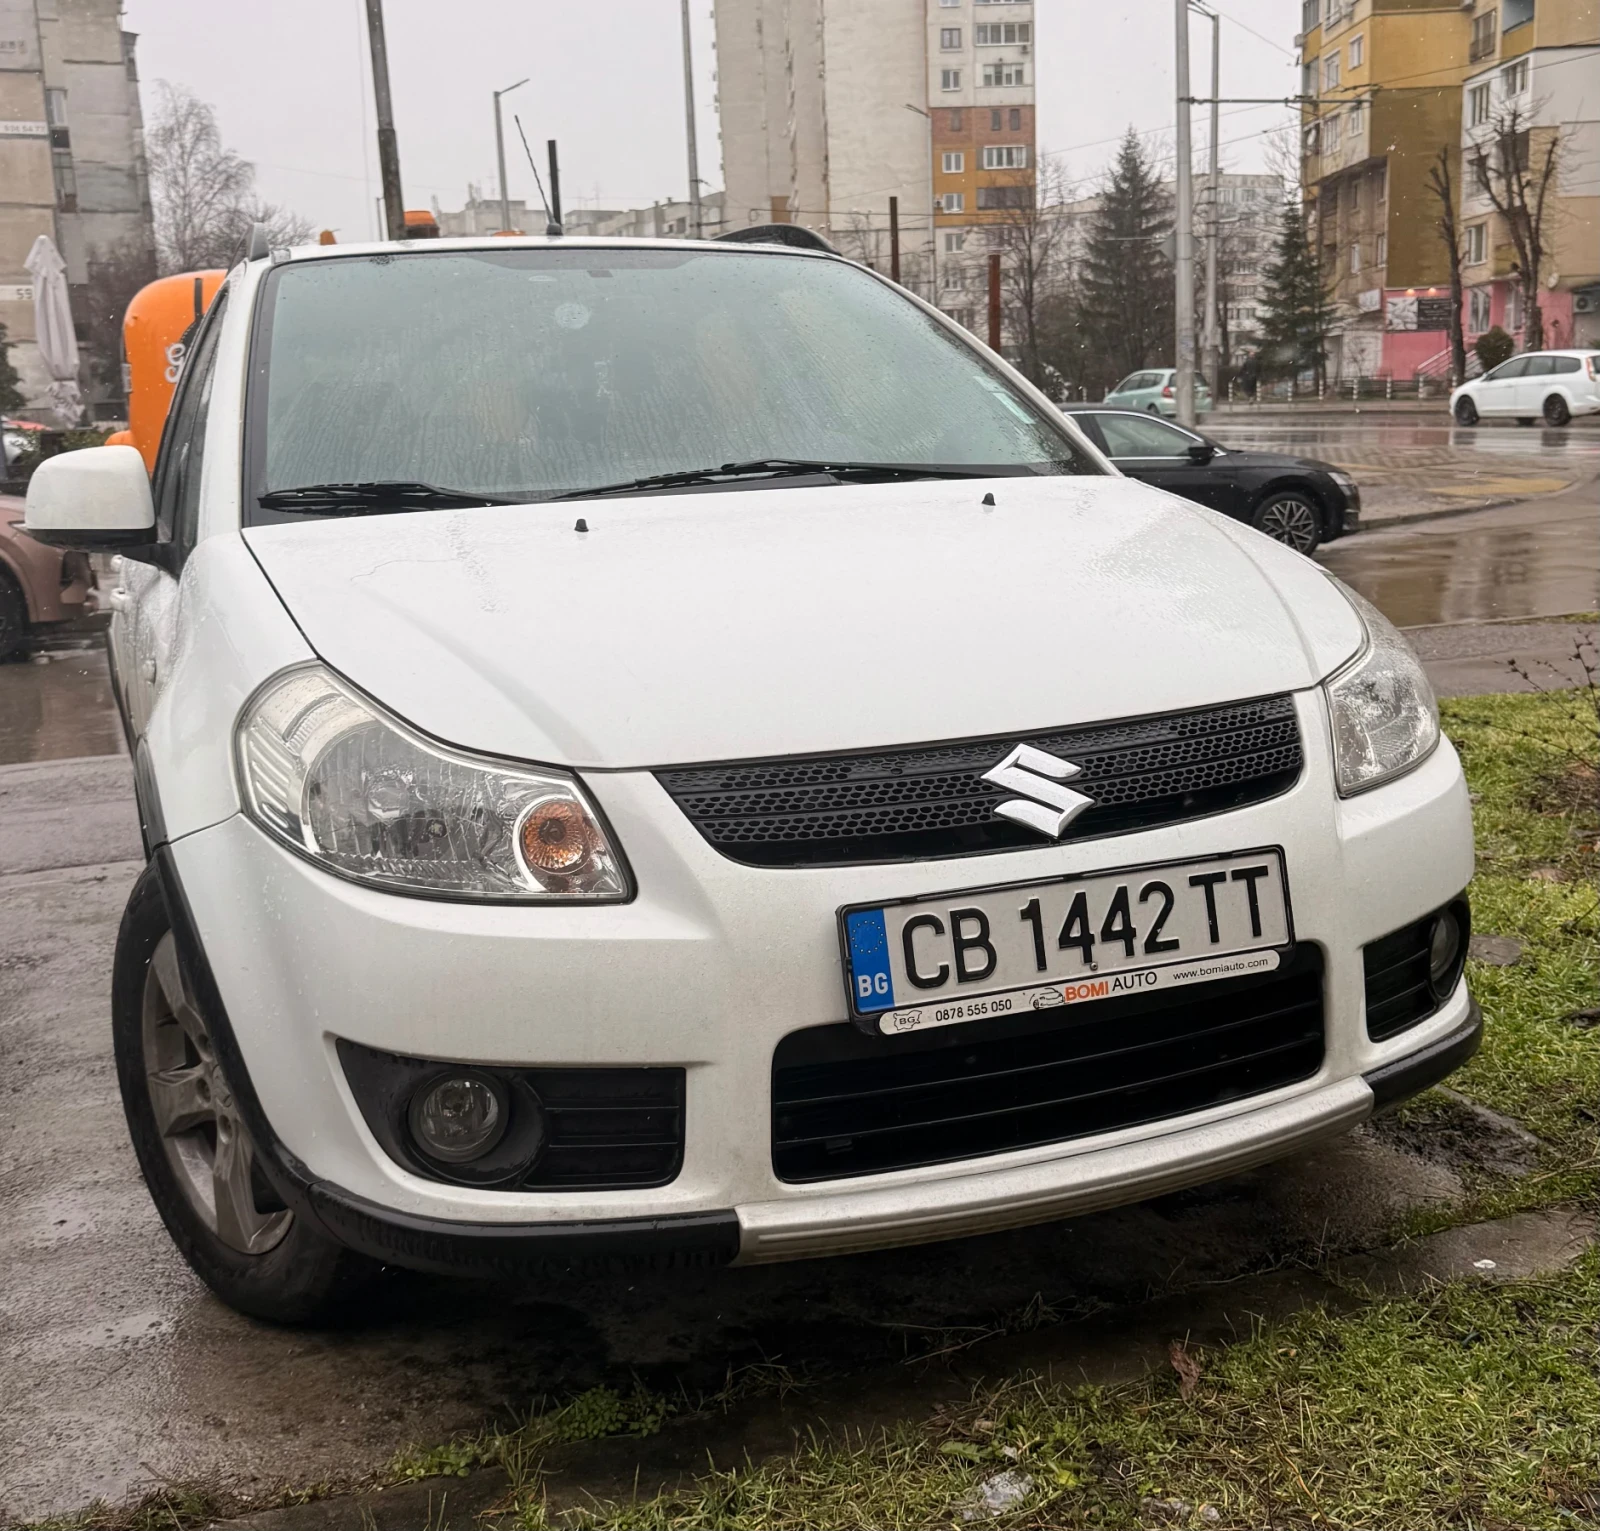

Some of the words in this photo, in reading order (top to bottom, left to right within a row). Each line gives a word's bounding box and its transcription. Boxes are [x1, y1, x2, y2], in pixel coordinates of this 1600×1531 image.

[901, 907, 998, 990] CB
[1020, 881, 1180, 972] 1442
[1188, 865, 1269, 944] TT
[1172, 957, 1269, 980] www.bomiauto.com
[858, 972, 889, 997] BG
[1065, 980, 1109, 1002] BOMI
[1112, 971, 1158, 992] AUTO
[898, 1015, 916, 1025] BG
[935, 1006, 964, 1022] 0878
[967, 1003, 988, 1017] 555
[991, 998, 1012, 1013] 050
